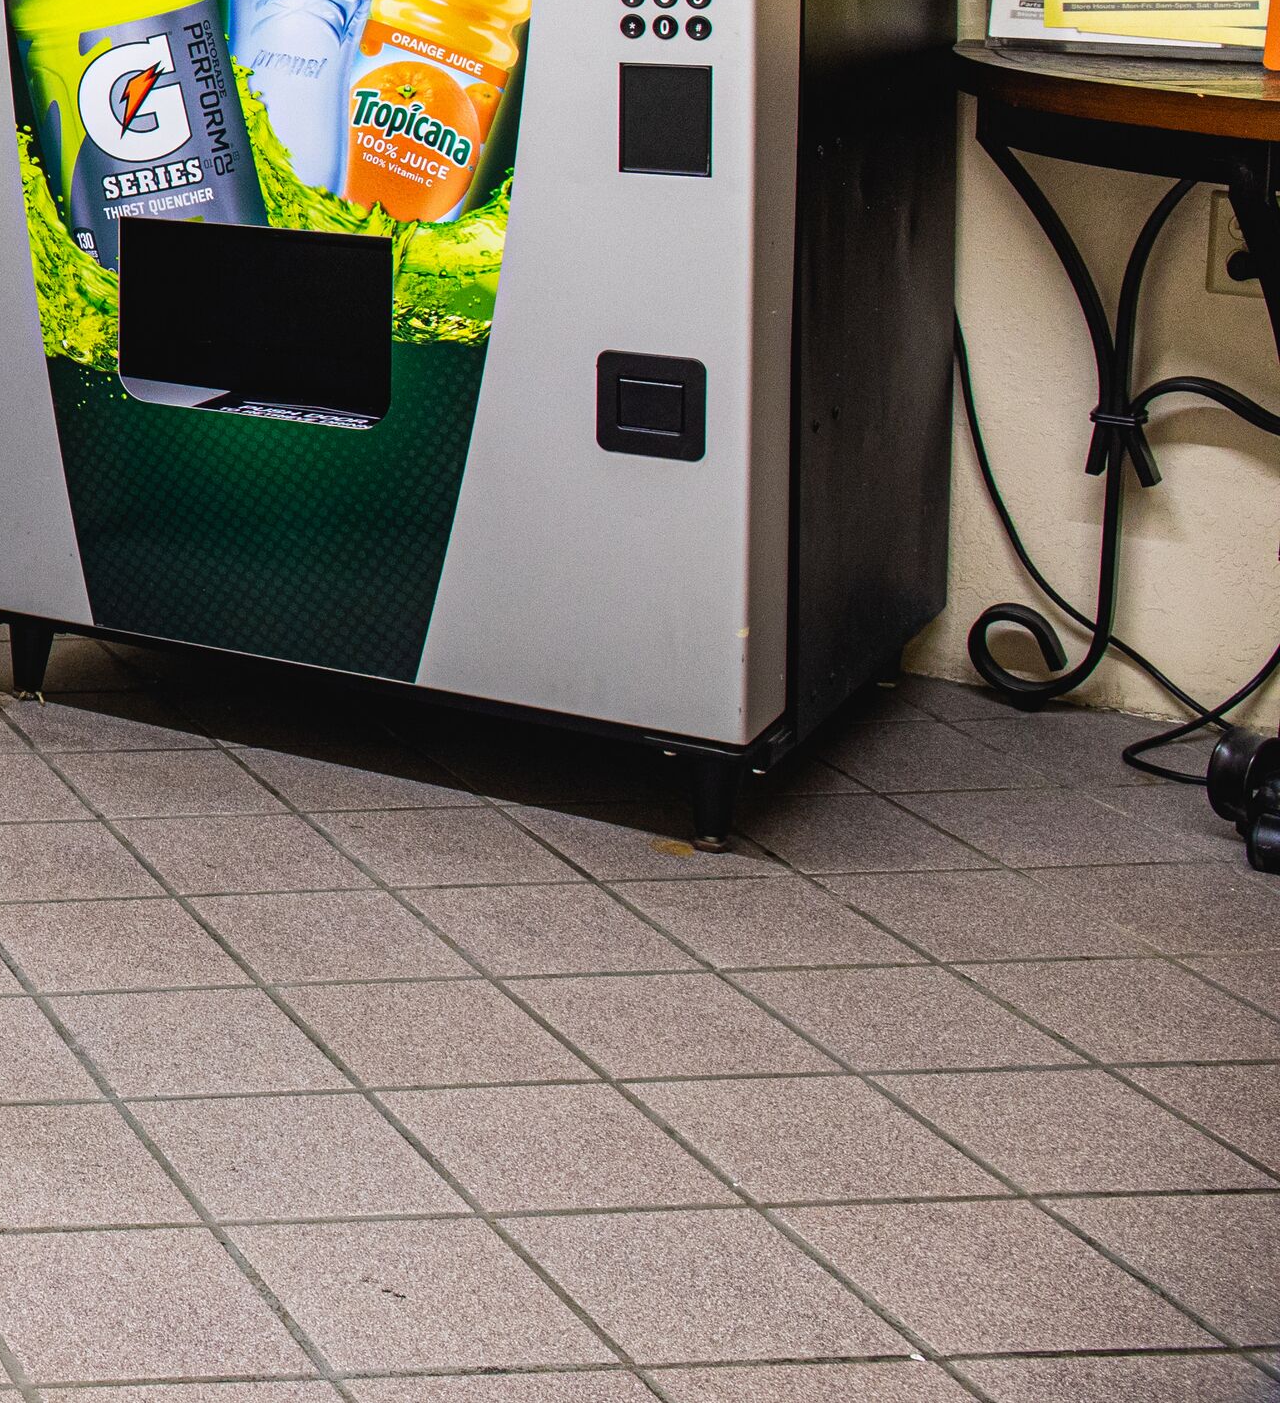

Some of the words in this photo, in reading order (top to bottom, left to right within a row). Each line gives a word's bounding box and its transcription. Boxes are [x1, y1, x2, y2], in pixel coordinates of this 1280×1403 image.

[661, 20, 670, 34] 0
[203, 20, 227, 98] GATORADE
[391, 33, 444, 59] ORANGE
[446, 52, 484, 75] JUICE
[78, 33, 192, 163] G
[184, 22, 233, 154] PERFORM
[353, 90, 472, 167] Tropicana
[356, 131, 399, 159] 100%
[400, 150, 450, 180] JUICE
[362, 152, 385, 168] 100%
[388, 162, 425, 185] Vitamin
[425, 179, 433, 188] C
[101, 157, 204, 201] SERIES
[103, 201, 144, 220] THIRST
[149, 188, 214, 215] QUENCHER
[77, 233, 94, 249] 130
